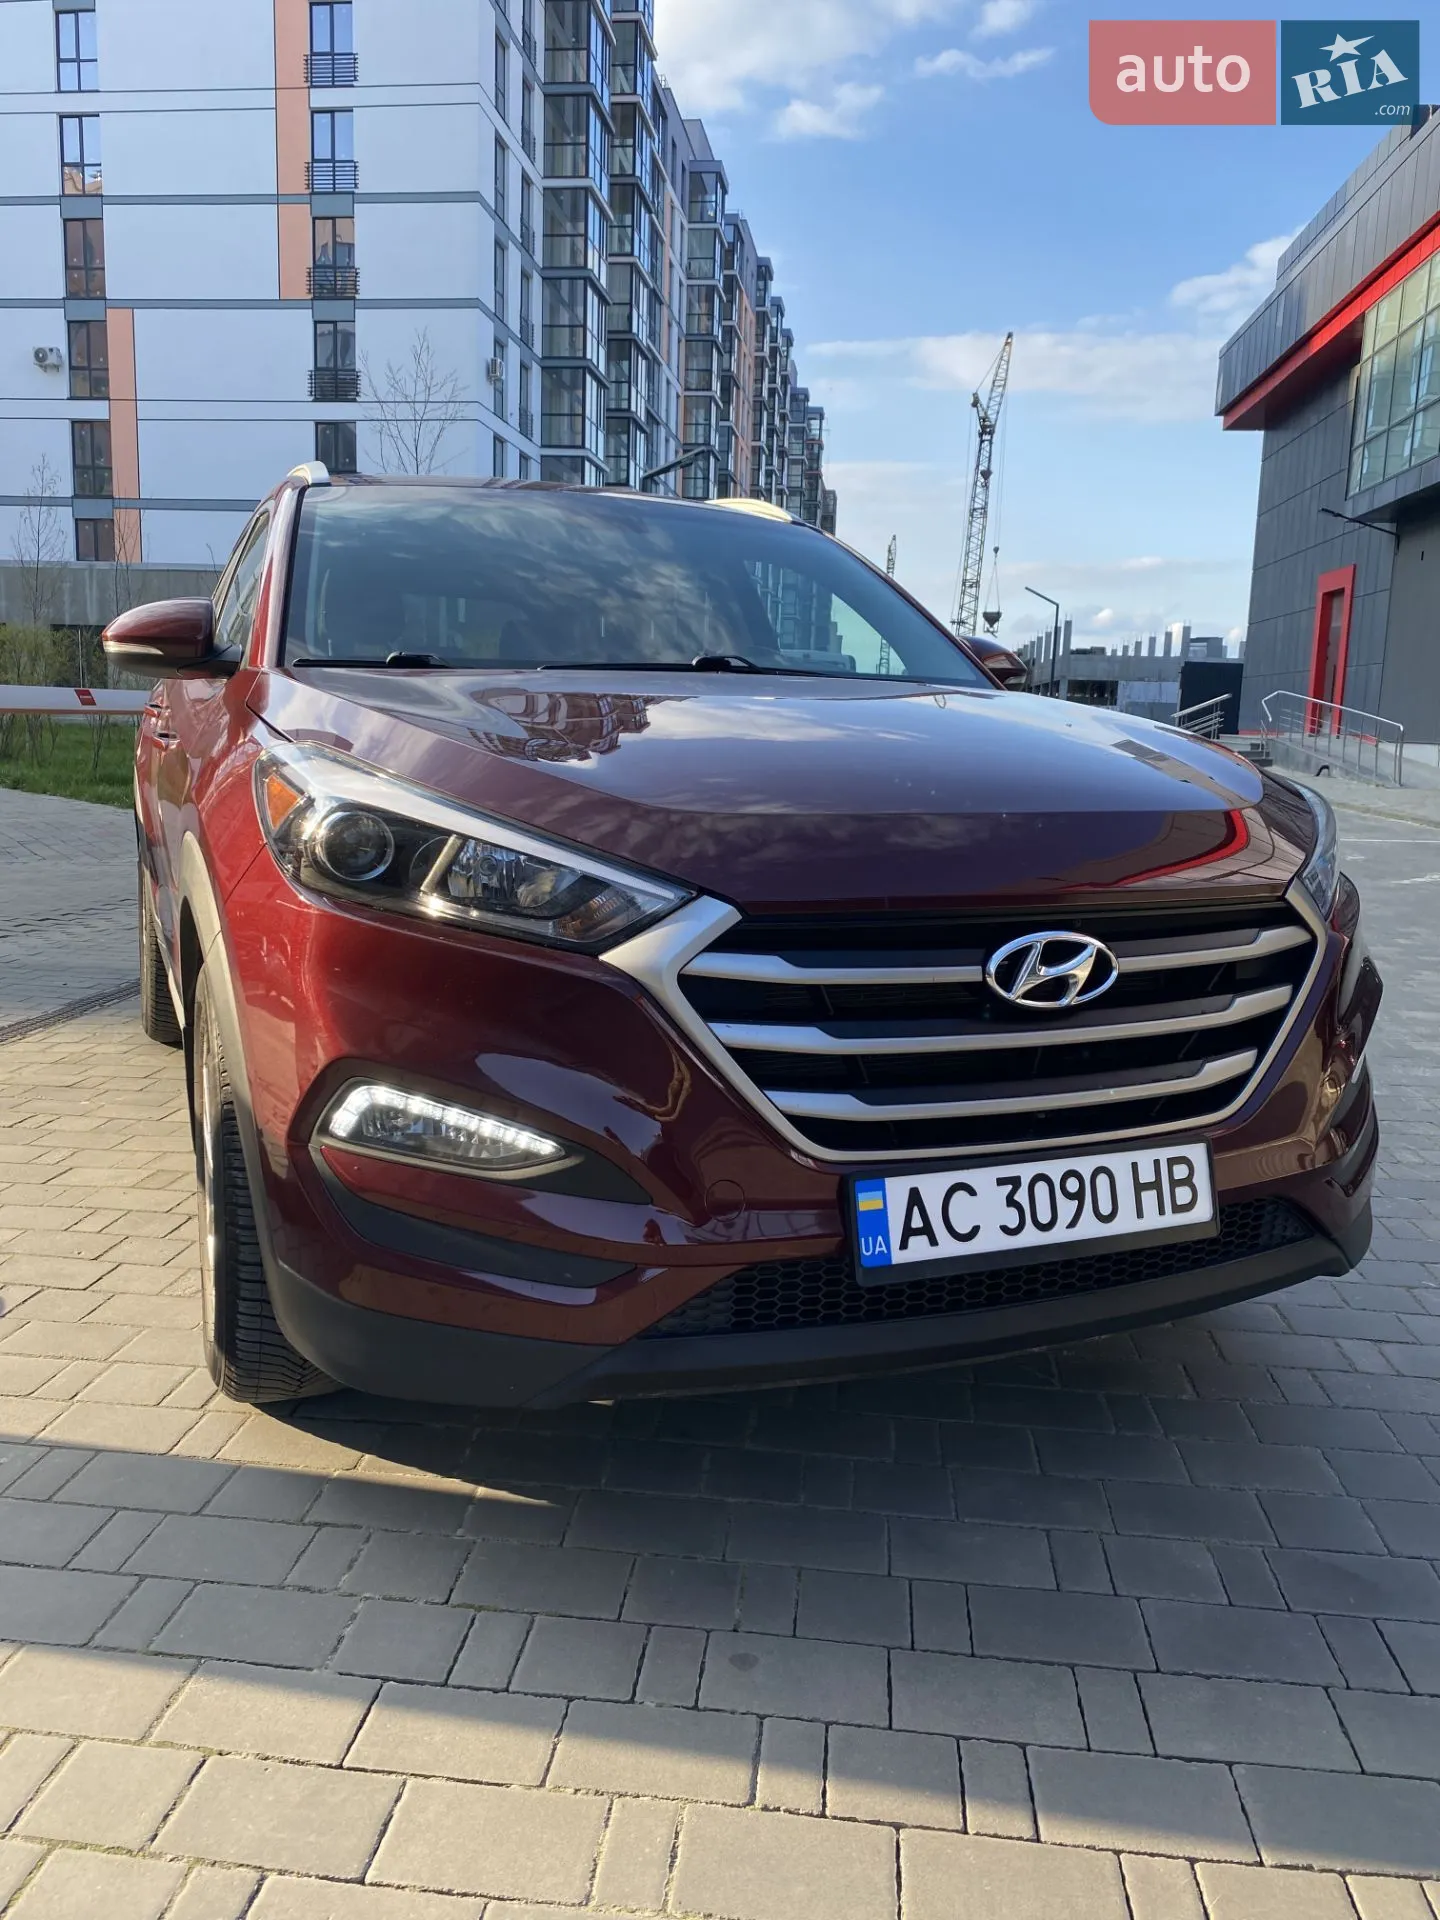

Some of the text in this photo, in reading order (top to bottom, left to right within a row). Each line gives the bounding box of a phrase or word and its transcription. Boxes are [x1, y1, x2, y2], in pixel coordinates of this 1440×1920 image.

[898, 1155, 1198, 1251] AC 3090 HB
[861, 1235, 888, 1256] UA
